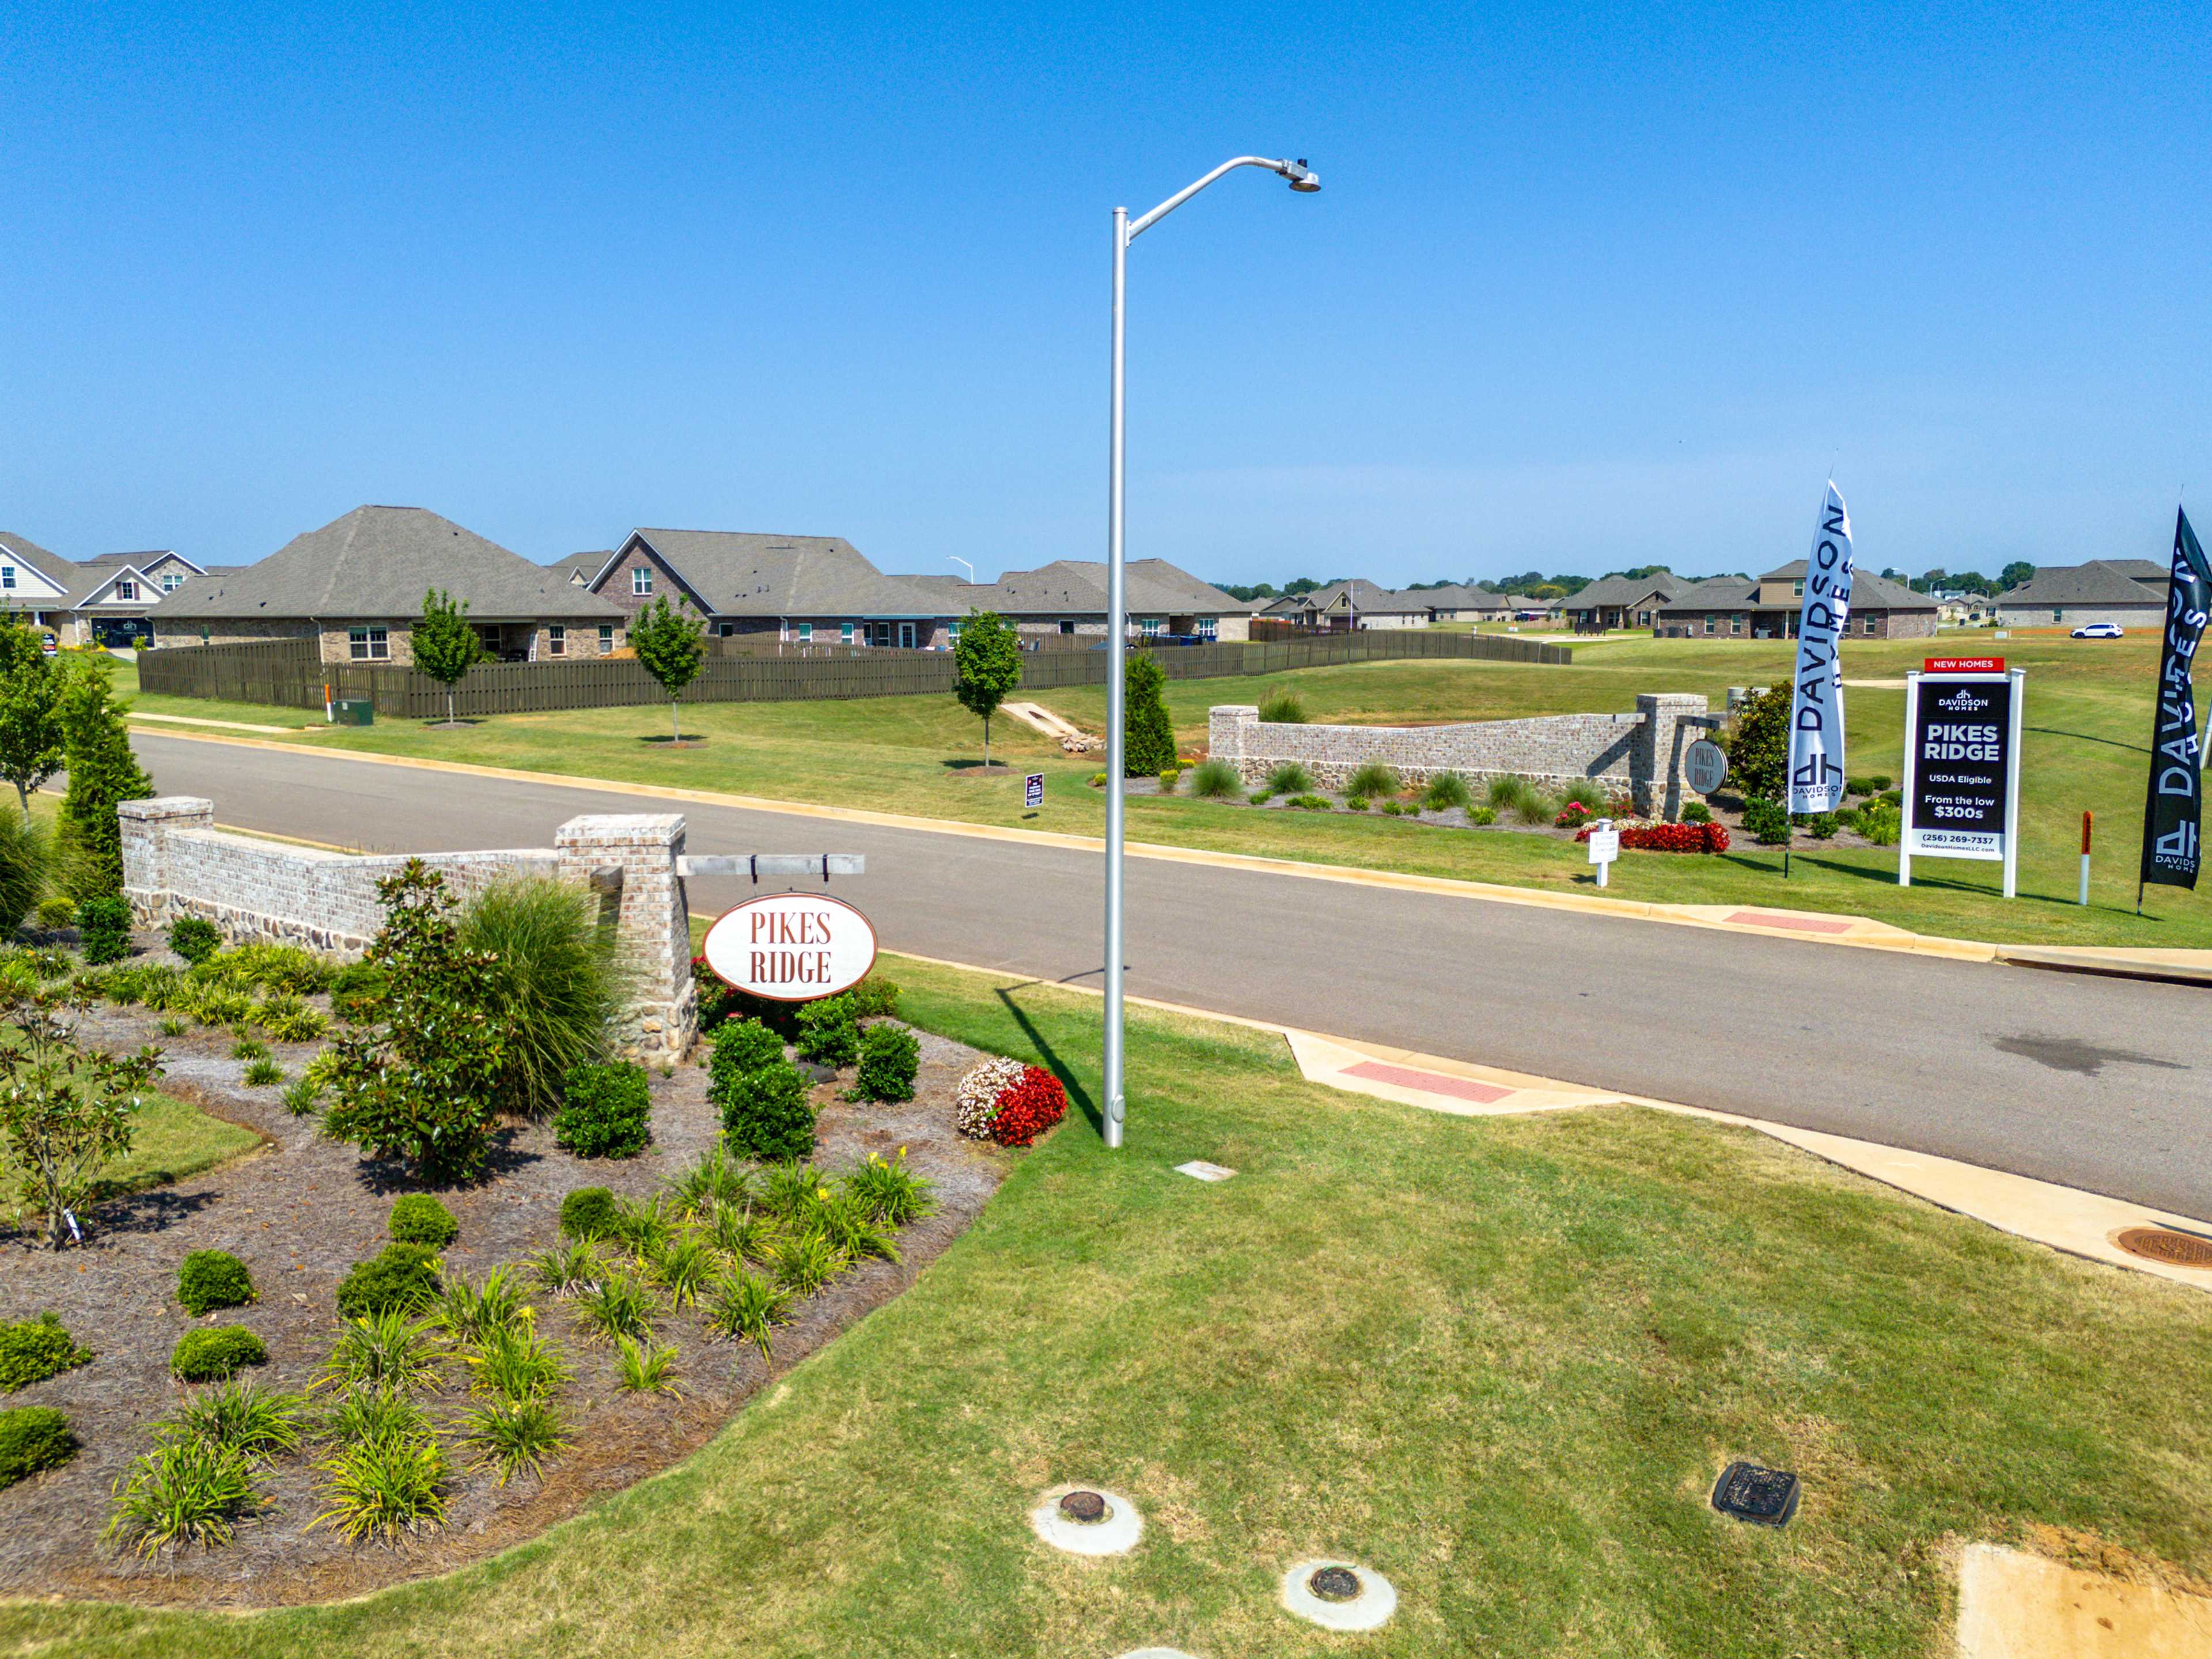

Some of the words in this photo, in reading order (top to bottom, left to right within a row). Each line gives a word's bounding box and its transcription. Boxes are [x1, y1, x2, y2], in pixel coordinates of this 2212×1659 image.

[1797, 505, 1846, 731] DAVIDSON
[1927, 725, 1998, 743] PIKES
[1695, 748, 1714, 767] PIKES
[1925, 743, 1999, 761] RIDGE
[1958, 776, 1992, 785] Eligible
[1925, 795, 1953, 804] From
[1955, 796, 1972, 805] the
[1975, 797, 1995, 806] low
[1934, 805, 1984, 819] $300s
[1923, 834, 1947, 843] (256)
[1950, 835, 1994, 844] 269-7337
[1921, 843, 1995, 853] DavidsonHomesLLC.com
[2156, 855, 2195, 868] DAVIDS
[2168, 864, 2193, 873] HOME
[750, 912, 831, 945] PIKES
[749, 951, 831, 983] RIDGE
